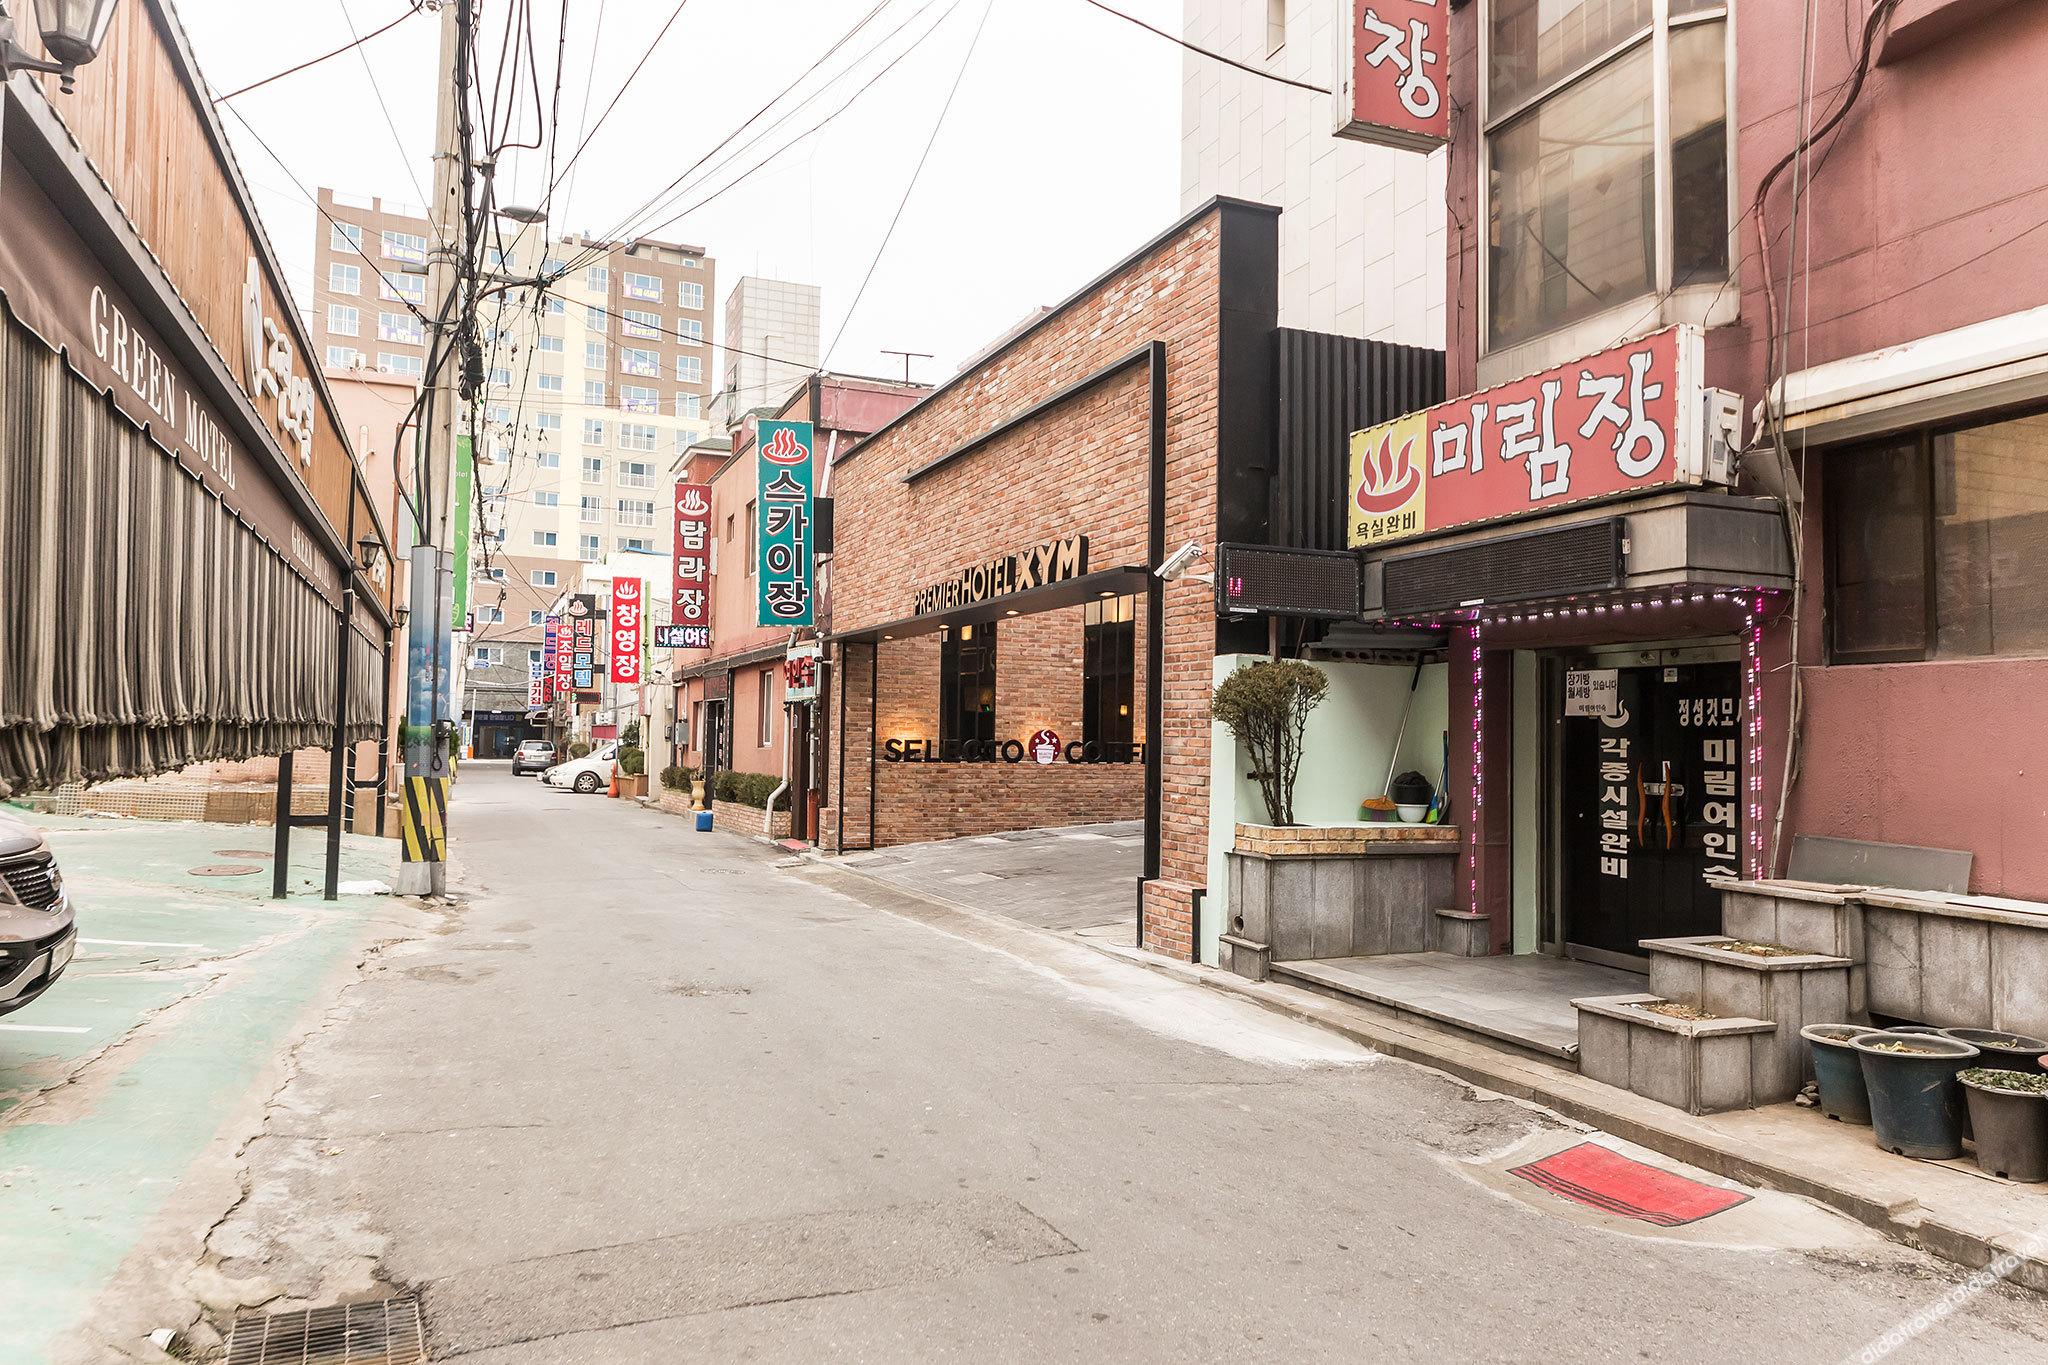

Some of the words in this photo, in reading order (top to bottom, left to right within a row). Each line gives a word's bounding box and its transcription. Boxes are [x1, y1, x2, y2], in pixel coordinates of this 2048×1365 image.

[1364, 0, 1441, 119] 장
[89, 285, 175, 429] GREEN
[184, 389, 236, 491] MOTEL
[1430, 348, 1667, 502] 미림장
[291, 520, 313, 571] GREEN
[762, 469, 811, 618] 스카이장
[1354, 509, 1418, 540] 욕실완비
[675, 518, 708, 620] 탐라장
[914, 580, 961, 616] PREMIER
[961, 556, 1017, 605] HOTEL
[1016, 534, 1090, 593] XYM
[557, 640, 573, 690] 조일장
[573, 618, 592, 688] 레드모텔
[615, 602, 640, 678] 창영장
[1567, 673, 1590, 686] 장기방
[1567, 686, 1591, 699] 월세방
[1592, 680, 1617, 691] 있습니다
[1599, 737, 1631, 879] 각종시설완비
